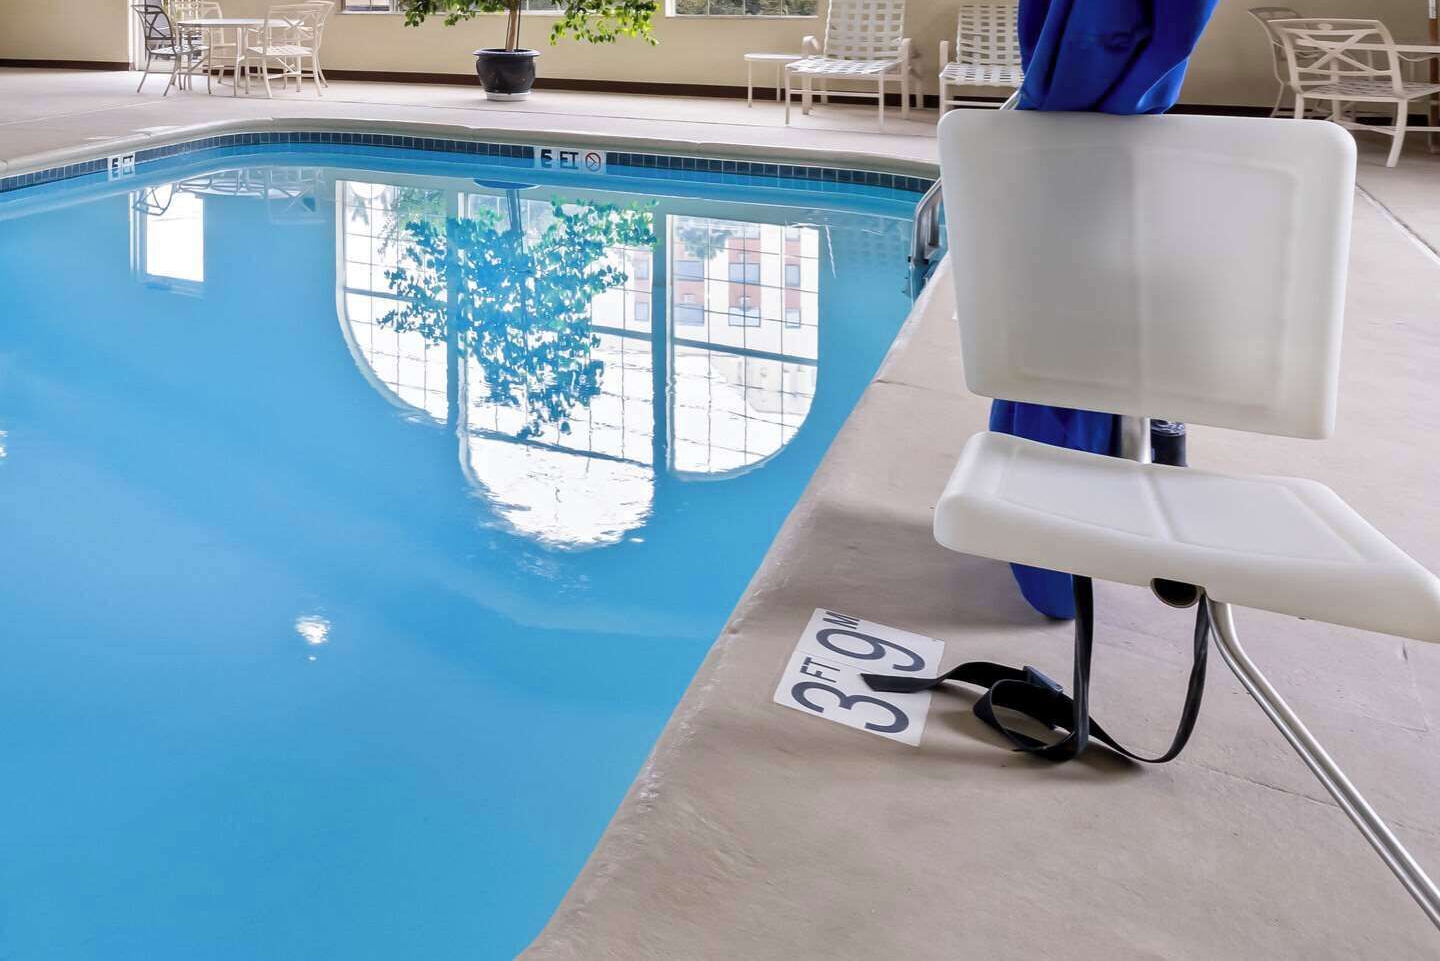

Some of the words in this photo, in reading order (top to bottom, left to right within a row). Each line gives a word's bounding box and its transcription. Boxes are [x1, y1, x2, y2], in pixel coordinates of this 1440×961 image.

[823, 611, 860, 630] M
[800, 656, 840, 683] FT
[791, 681, 909, 734] 3
